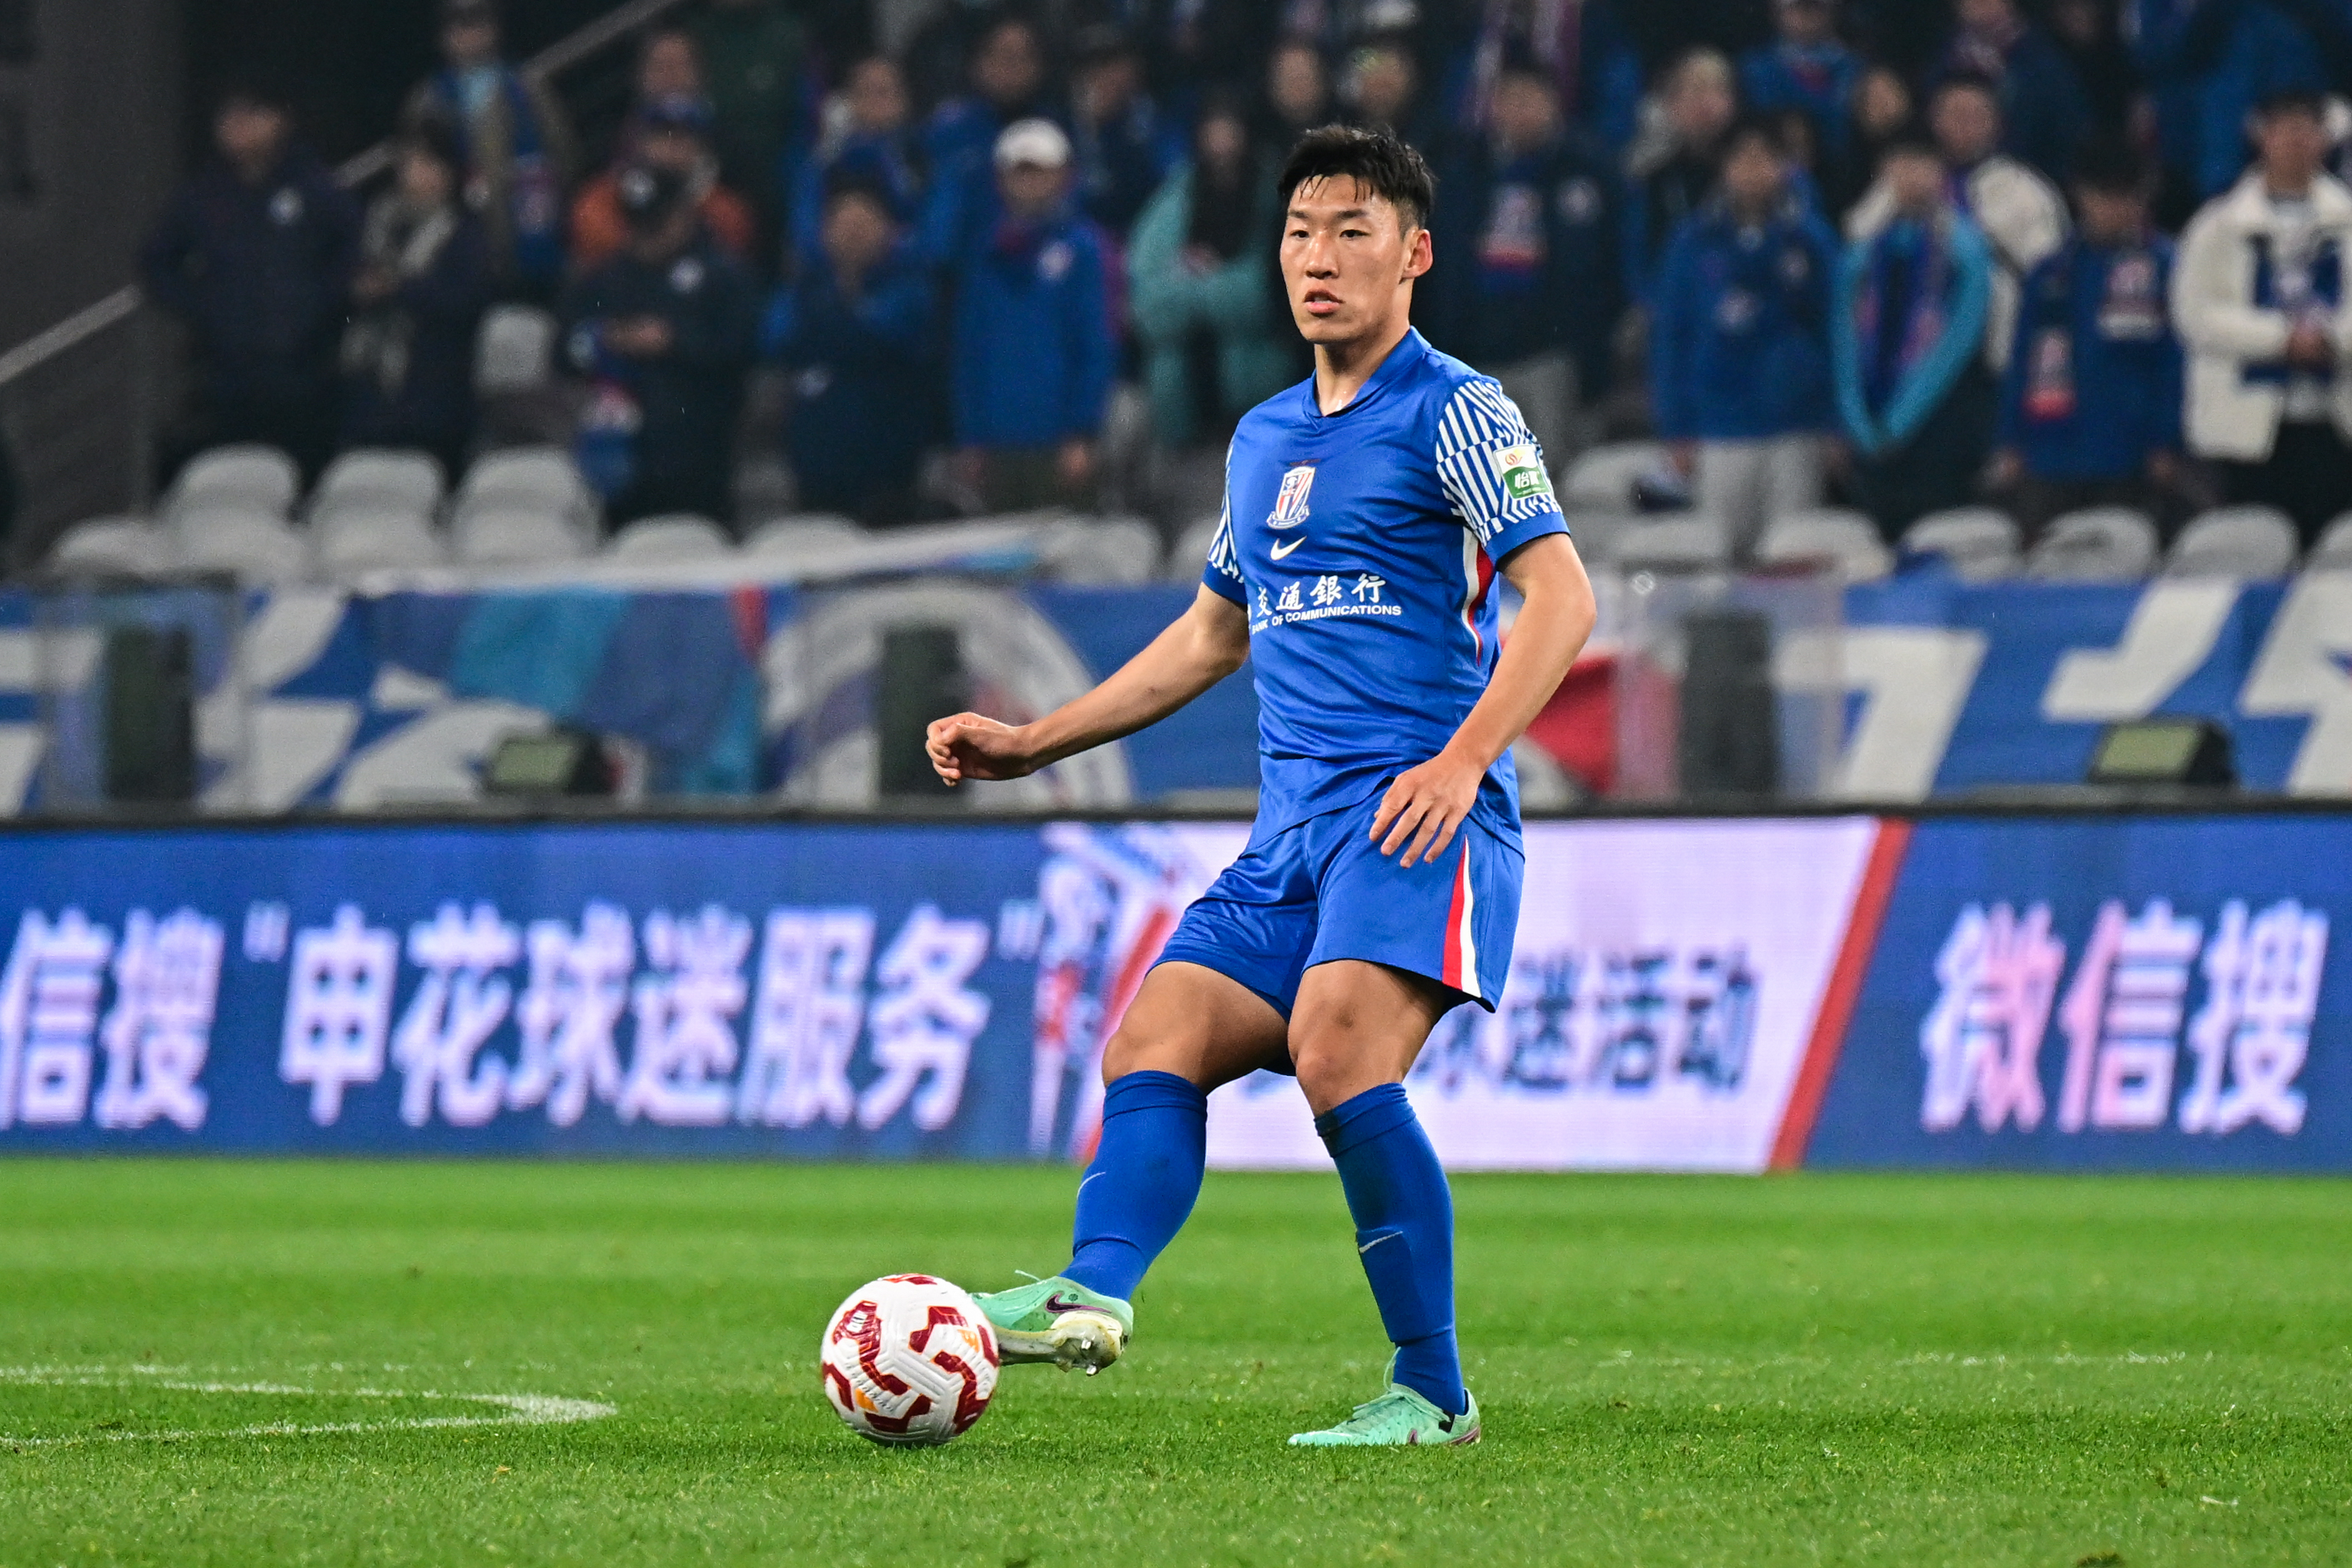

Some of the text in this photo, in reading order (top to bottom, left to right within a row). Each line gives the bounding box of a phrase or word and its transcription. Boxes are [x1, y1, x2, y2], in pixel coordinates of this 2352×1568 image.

[1256, 573, 1386, 618] 交通銀行
[1271, 615, 1284, 626] OF
[1285, 605, 1402, 623] COMMUNICATIONS
[1920, 898, 2330, 1133] 微信搜
